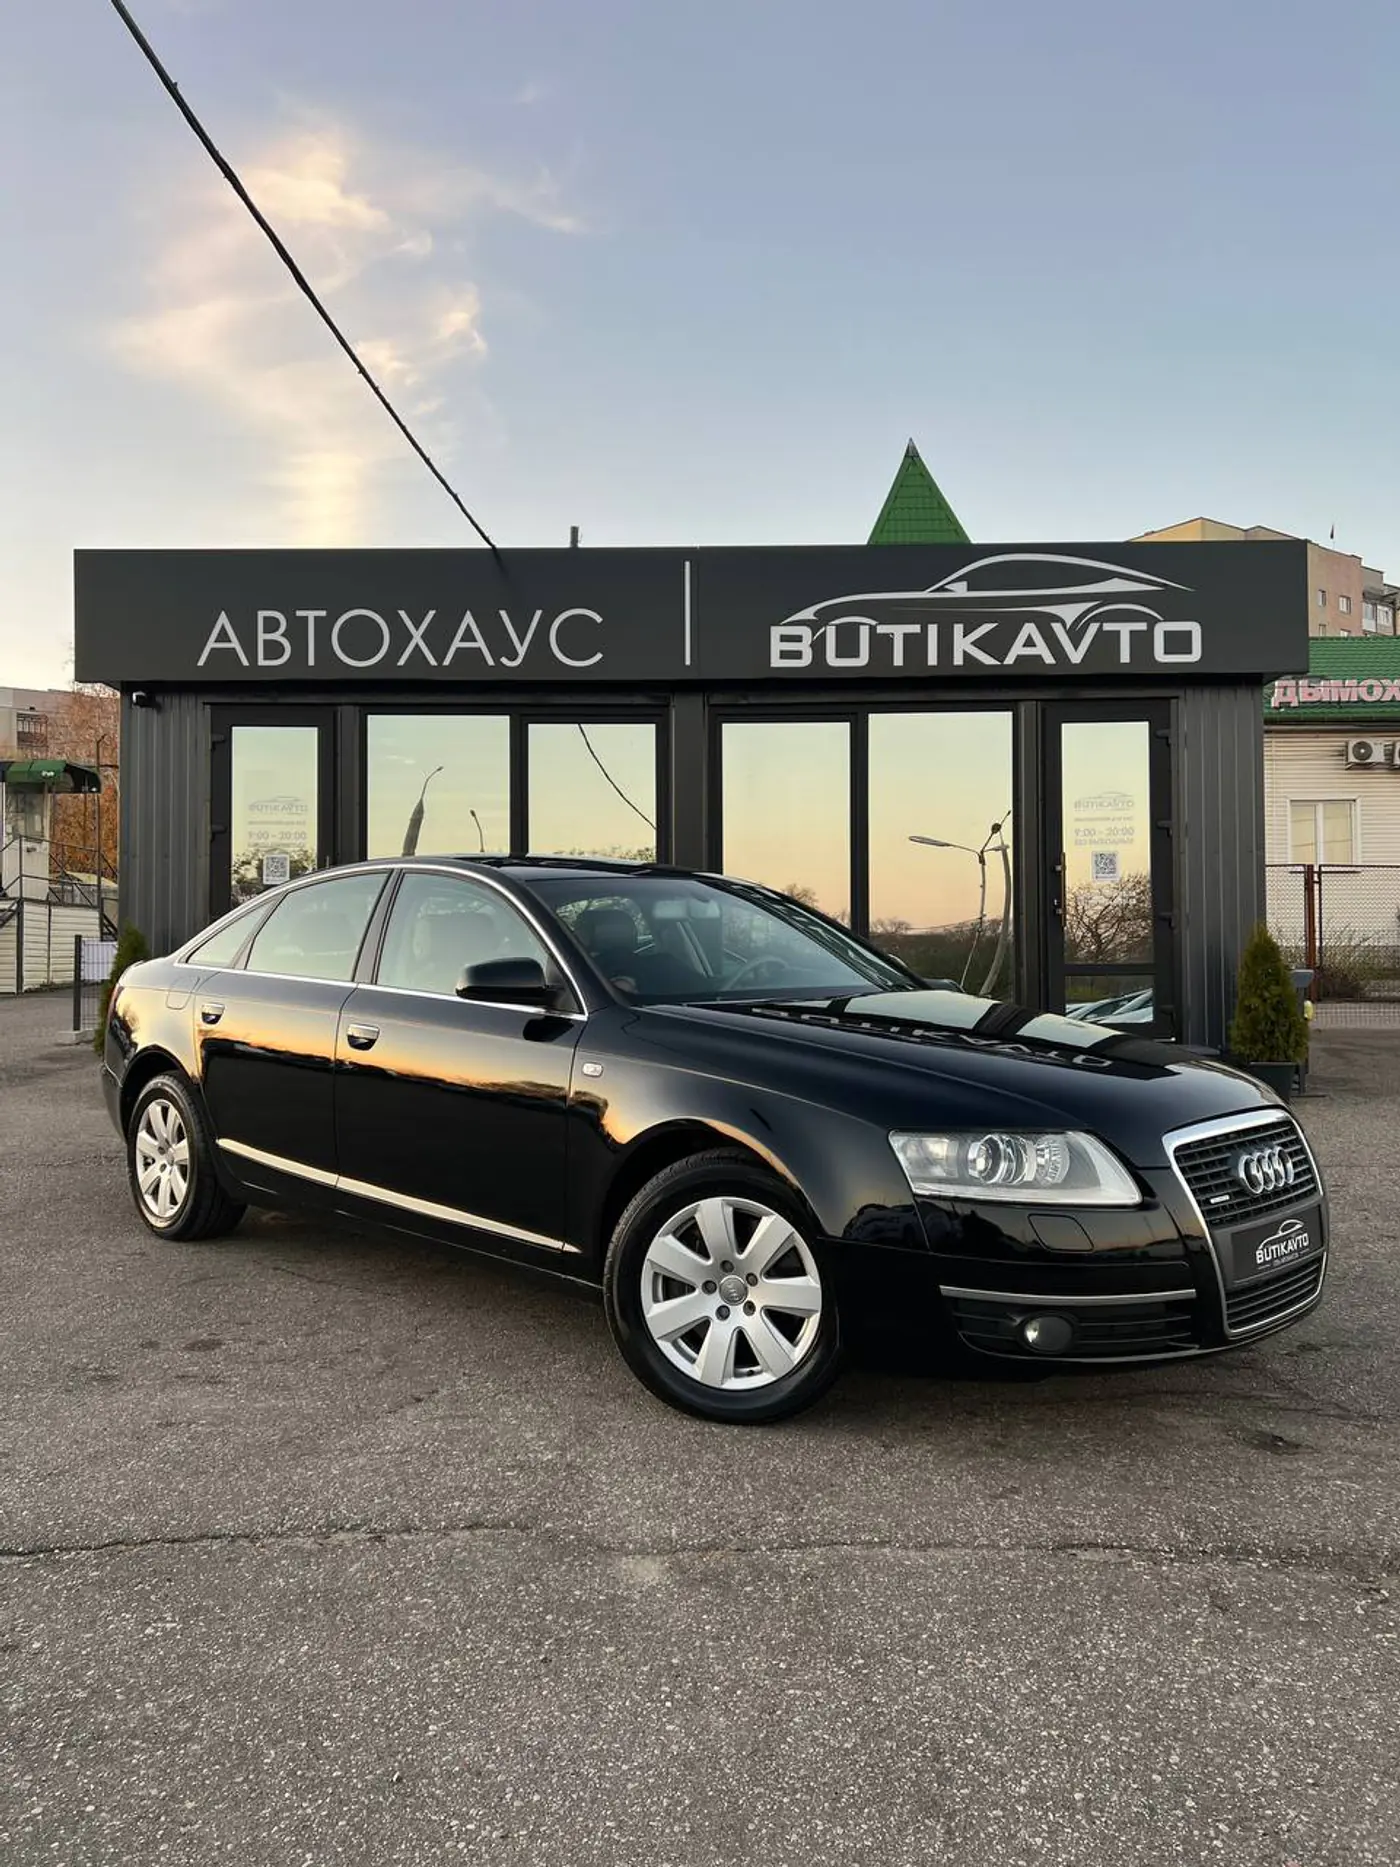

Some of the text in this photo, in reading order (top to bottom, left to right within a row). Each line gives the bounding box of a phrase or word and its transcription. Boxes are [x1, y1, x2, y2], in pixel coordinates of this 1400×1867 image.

[197, 608, 603, 668] АВТОХАУС
[770, 620, 1202, 668] BUTIKAVTO
[1256, 1232, 1310, 1265] BUTIKAVTO
